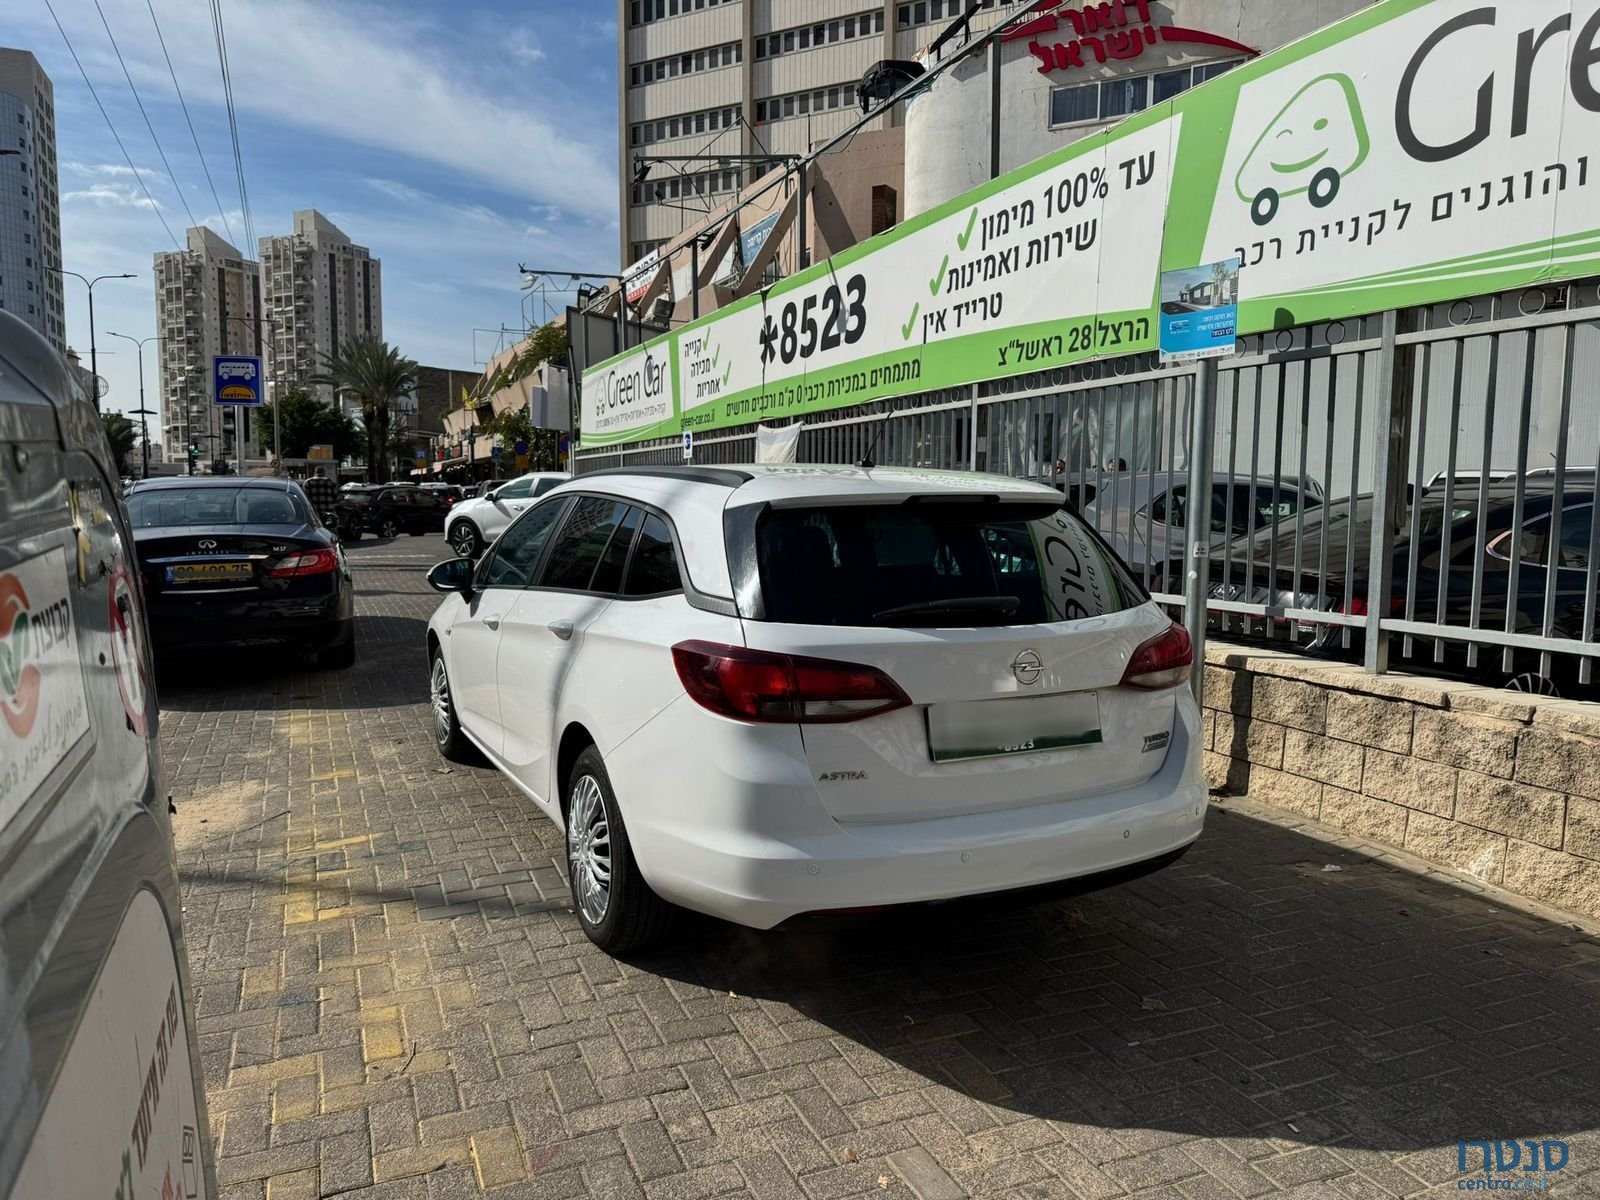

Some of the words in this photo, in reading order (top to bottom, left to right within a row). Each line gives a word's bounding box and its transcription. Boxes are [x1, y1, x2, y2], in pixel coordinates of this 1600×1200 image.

[1059, 0, 1151, 35] דואר
[1029, 24, 1157, 73] ישראל
[1119, 150, 1156, 190] עד
[1044, 167, 1109, 218] 100%
[1431, 156, 1588, 222] והוגנים
[981, 199, 1034, 251] מימון
[1296, 198, 1412, 255] לקניית
[1026, 218, 1097, 268] שירות
[1235, 237, 1282, 268] רכב
[946, 245, 1020, 294] ואמינות
[953, 292, 1003, 328] טרייד
[923, 308, 947, 344] אין
[1068, 324, 1092, 353] 28
[1098, 317, 1149, 347] הרצל
[684, 338, 701, 358] קנייה
[607, 370, 641, 408] Green
[644, 355, 666, 398] Car
[690, 358, 710, 378] מכירה
[870, 358, 921, 388] מתמחים
[696, 378, 721, 398] אחריות
[778, 387, 794, 408] ק"מ
[796, 385, 803, 404] 0
[804, 381, 825, 402] רכבי
[827, 372, 867, 398] במכירת
[726, 399, 750, 417] חדשים
[751, 393, 776, 414] ורכבים
[31, 597, 70, 659] קבוצת
[818, 770, 869, 781] ASTRA
